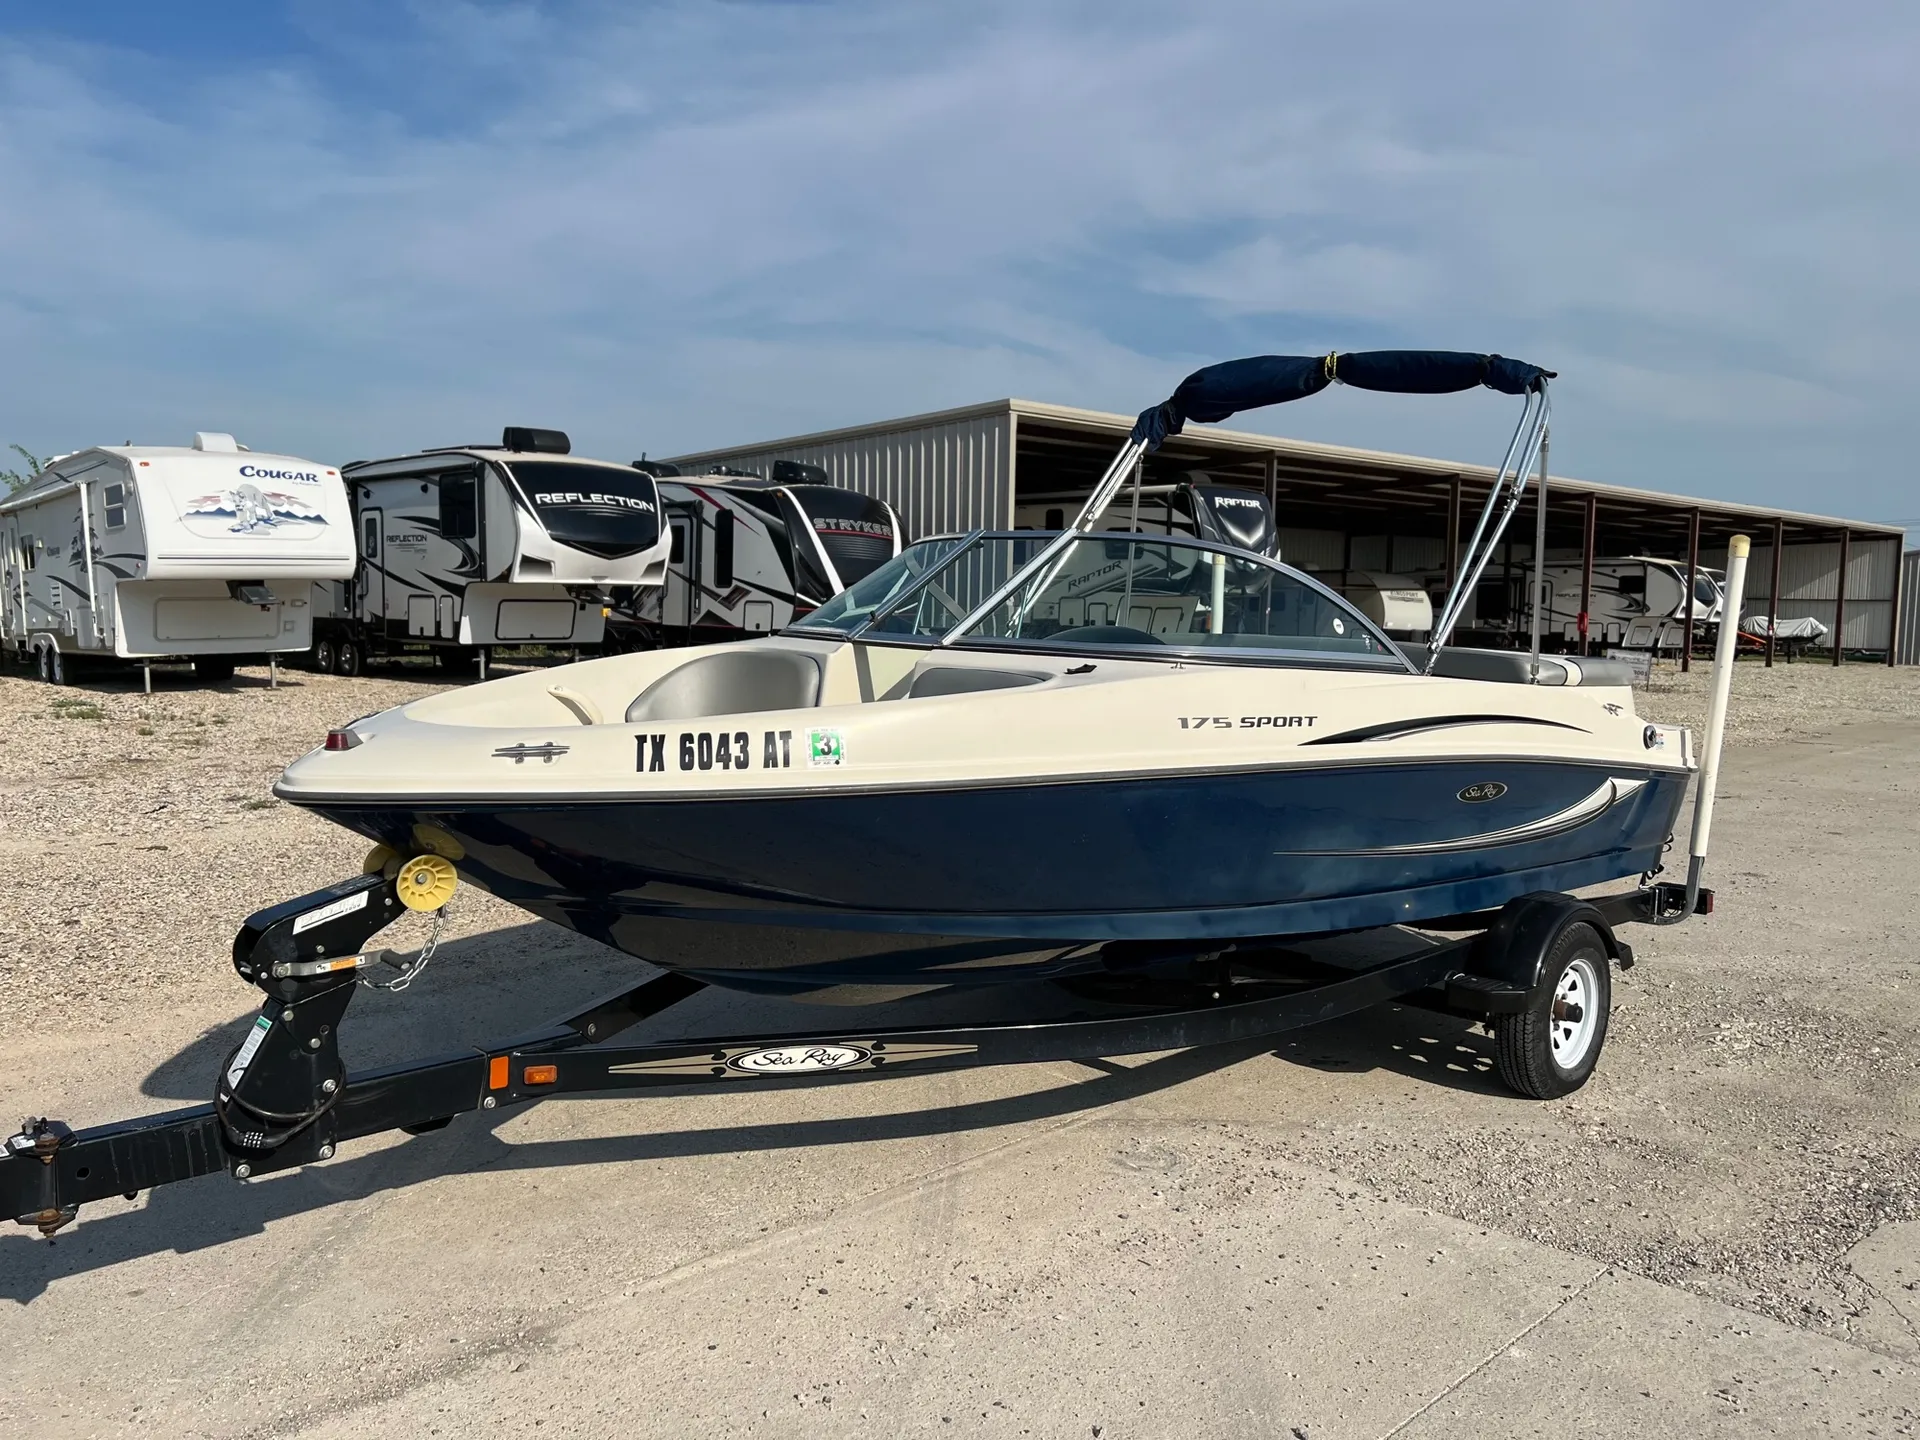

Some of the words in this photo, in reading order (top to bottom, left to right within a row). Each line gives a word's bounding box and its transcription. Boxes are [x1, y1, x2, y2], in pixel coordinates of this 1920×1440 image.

[239, 465, 319, 483] COUGAR
[534, 493, 655, 513] REFLECTION
[1214, 496, 1264, 511] RAPTOR
[813, 517, 893, 537] STRYKER
[386, 534, 428, 543] REFLECTION
[1068, 560, 1124, 593] RAPTOR
[1177, 716, 1233, 729] 175
[1239, 716, 1318, 728] SPORT
[634, 733, 666, 772] TX
[679, 731, 750, 771] 6043
[763, 730, 792, 769] AT
[819, 732, 832, 756] 3
[1465, 786, 1481, 798] Sea
[1481, 783, 1499, 798] Ray
[753, 1052, 798, 1066] Sea
[800, 1048, 845, 1066] Ray
